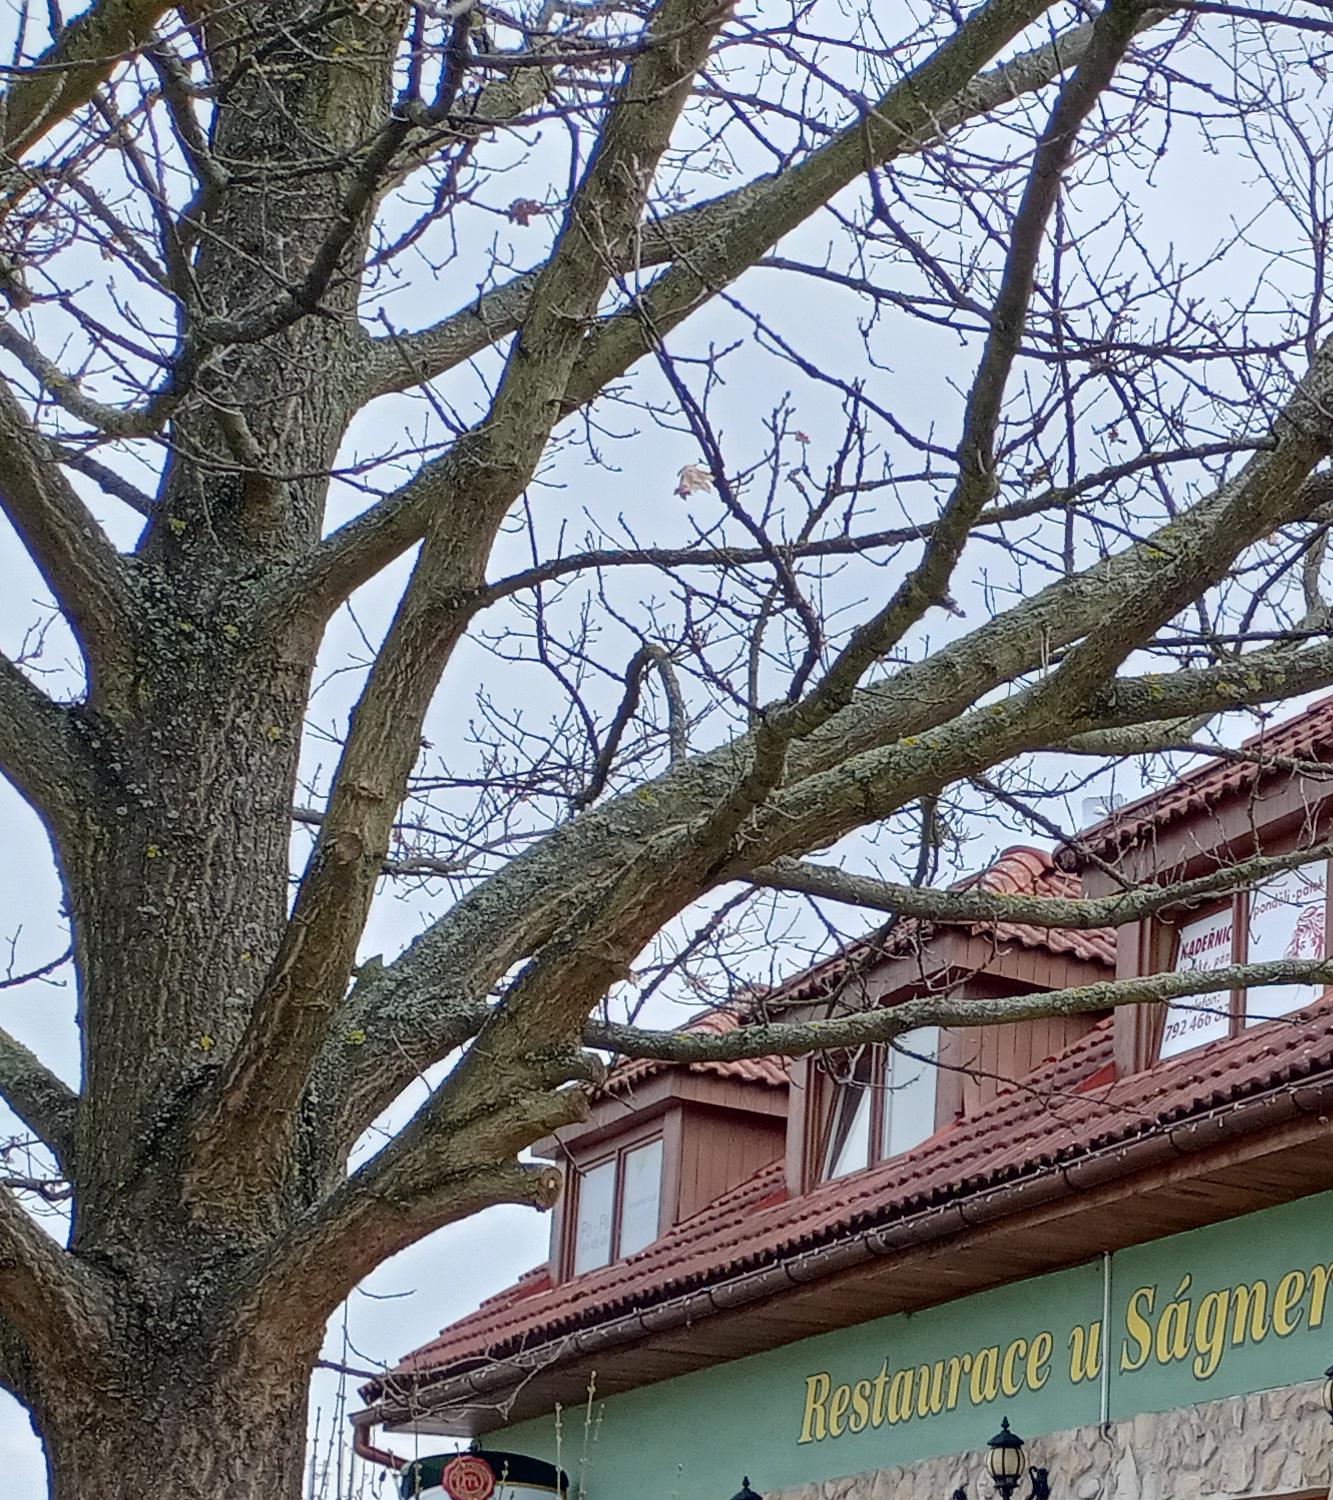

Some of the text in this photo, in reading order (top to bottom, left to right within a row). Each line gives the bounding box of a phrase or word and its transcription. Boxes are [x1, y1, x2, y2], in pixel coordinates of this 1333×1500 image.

[1164, 1018, 1188, 1042] 792
[1189, 1012, 1211, 1032] 466
[798, 1330, 1054, 1445] Restaurace
[1068, 1319, 1102, 1383] u
